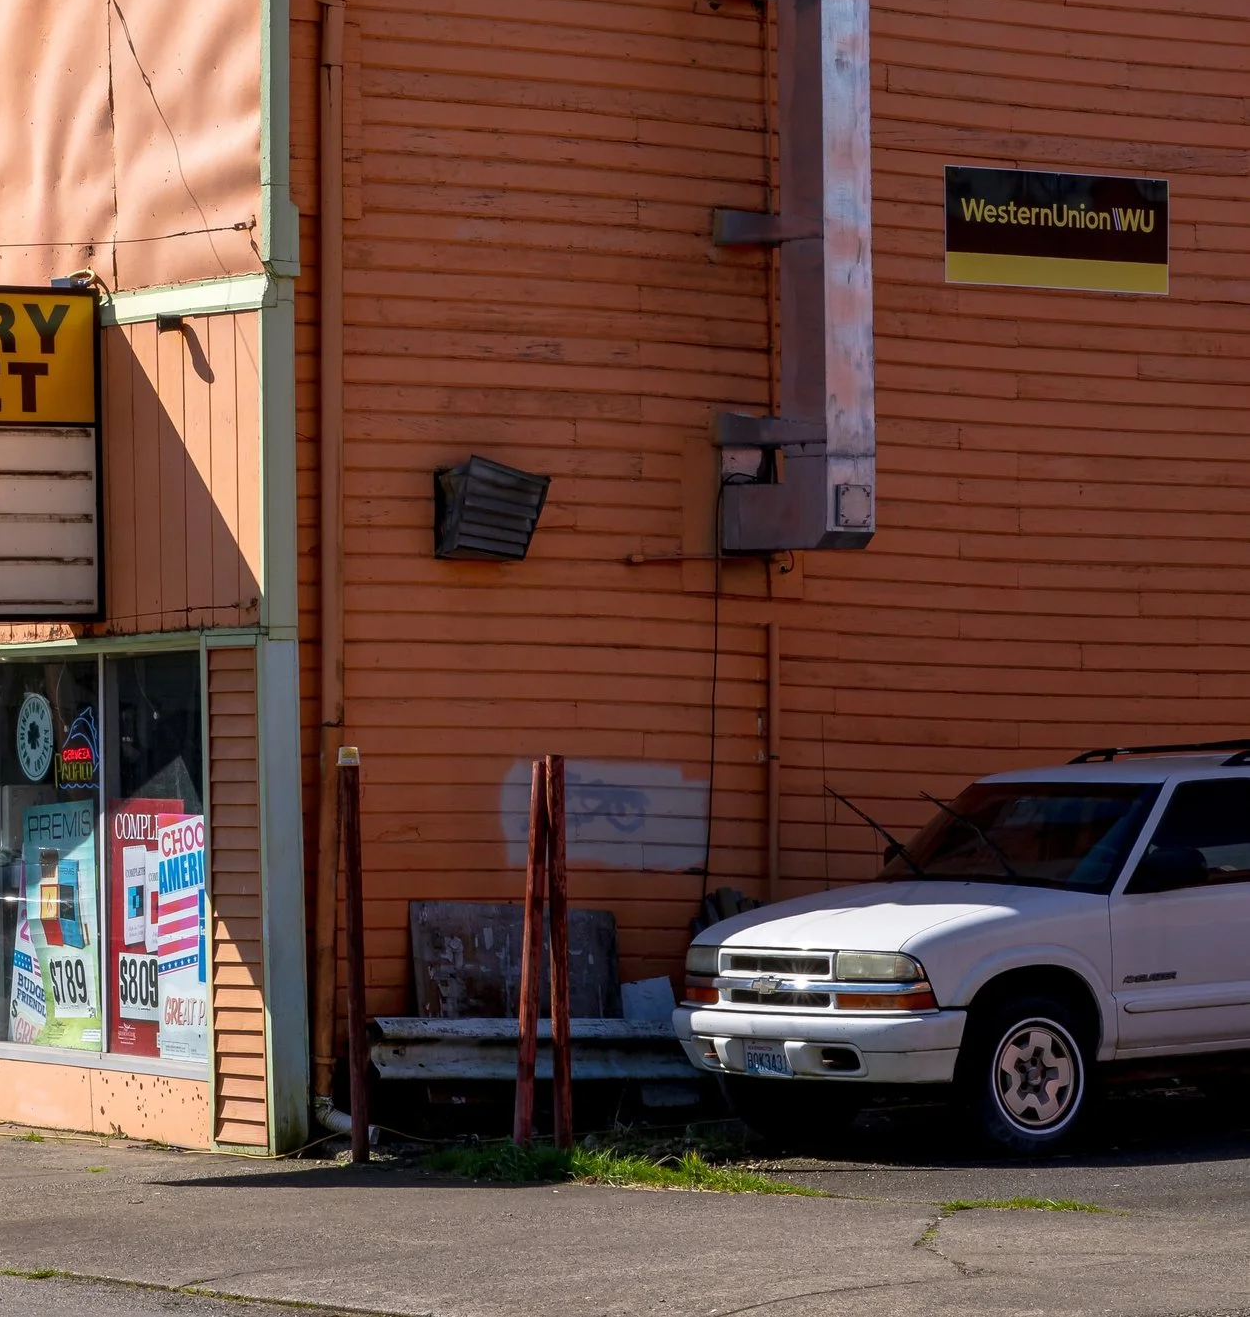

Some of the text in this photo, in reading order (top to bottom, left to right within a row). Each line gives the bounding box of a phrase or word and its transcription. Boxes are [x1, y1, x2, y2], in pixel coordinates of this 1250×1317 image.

[960, 197, 1111, 230] WesternUnion
[28, 809, 91, 842] PREMIS
[159, 850, 205, 895] AMERI
[49, 958, 88, 1006] $789
[119, 956, 159, 1009] $809
[15, 1017, 42, 1044] GRE
